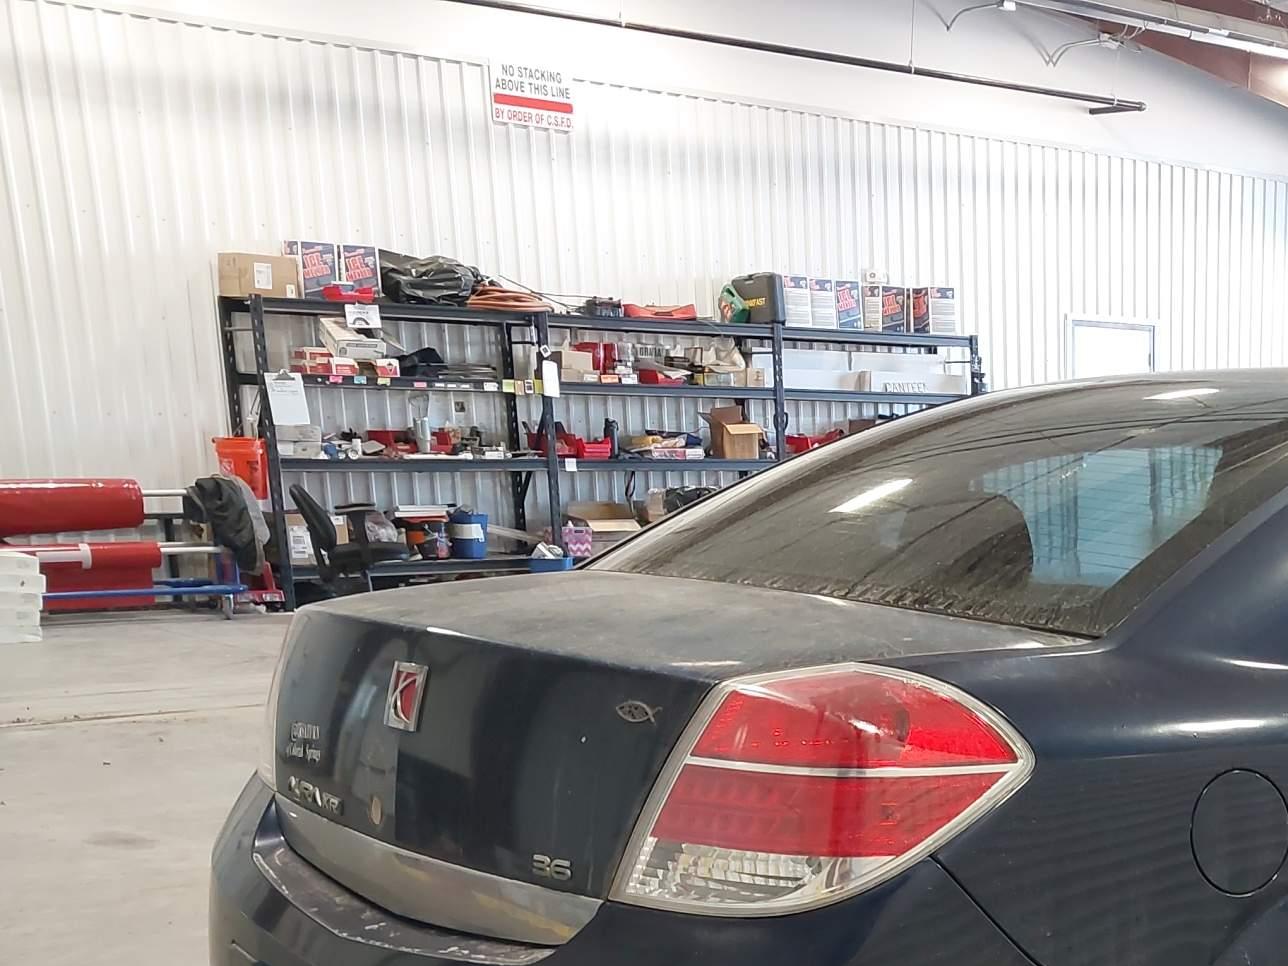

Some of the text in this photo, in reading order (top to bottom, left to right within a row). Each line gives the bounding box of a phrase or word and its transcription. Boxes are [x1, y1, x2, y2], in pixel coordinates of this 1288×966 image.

[501, 64, 562, 84] NO STACKING
[495, 77, 571, 99] ABOVE THIS LINE
[494, 107, 505, 119] BY
[506, 109, 533, 123] ORDER
[534, 113, 545, 125] OF
